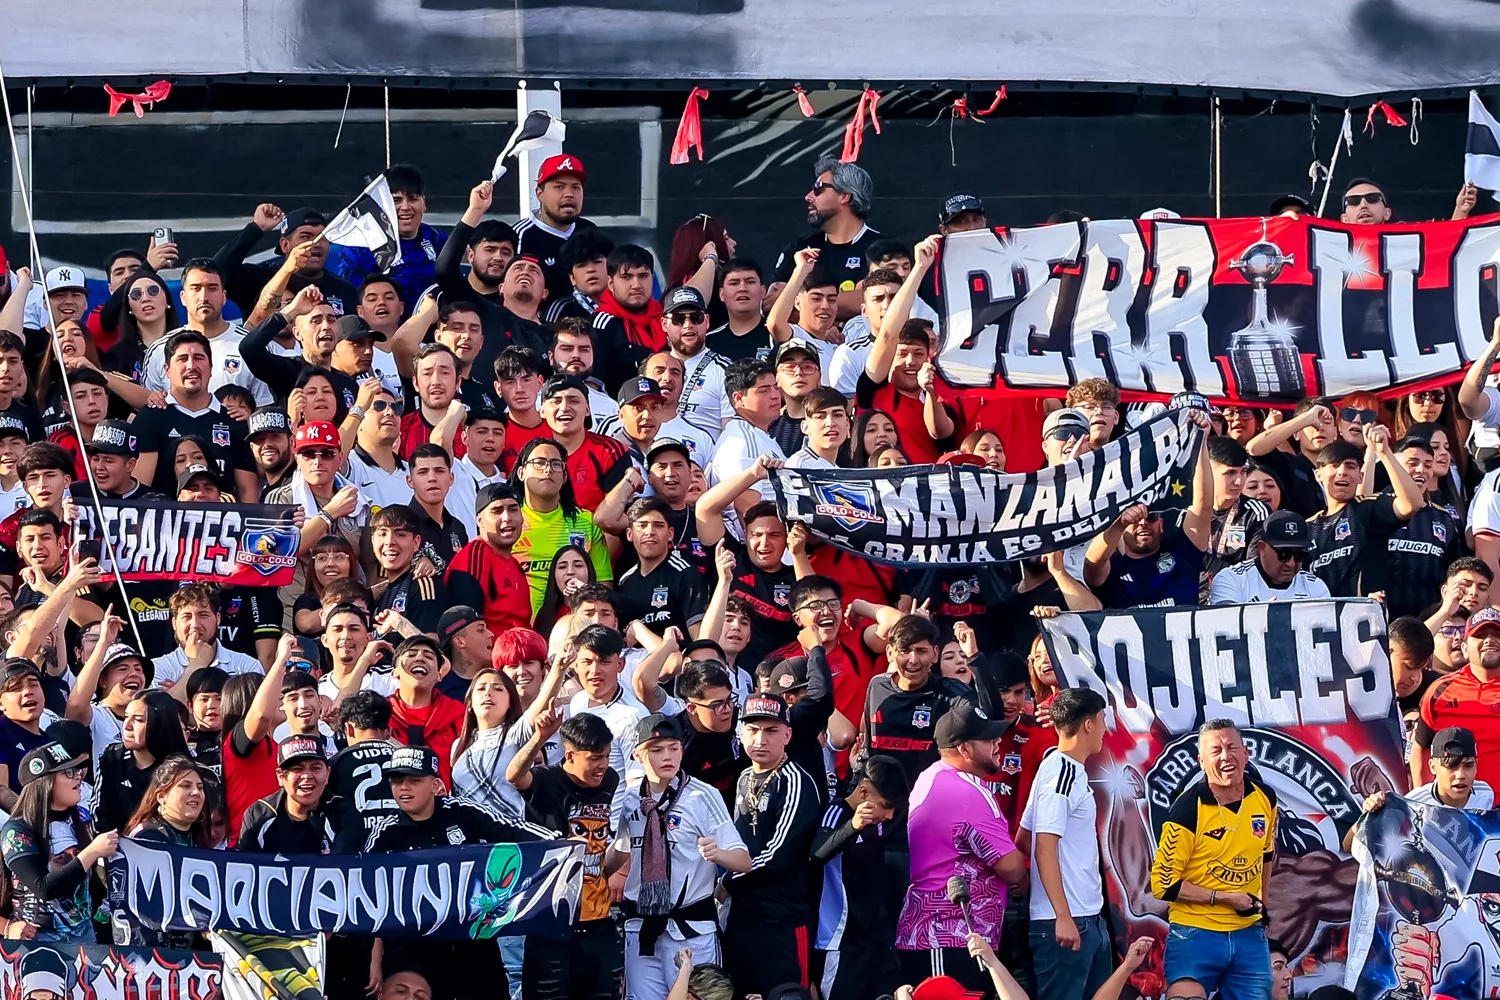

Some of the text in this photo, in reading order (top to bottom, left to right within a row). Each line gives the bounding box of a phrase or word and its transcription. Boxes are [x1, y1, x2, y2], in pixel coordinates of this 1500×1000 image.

[557, 157, 573, 170] A
[59, 269, 72, 282] NY
[306, 425, 319, 439] NY
[863, 515, 1104, 563] GRANJA ES DEL
[1333, 546, 1354, 558] BET
[1396, 540, 1431, 556] JUGA
[1152, 738, 1352, 819] GARR BLANCA
